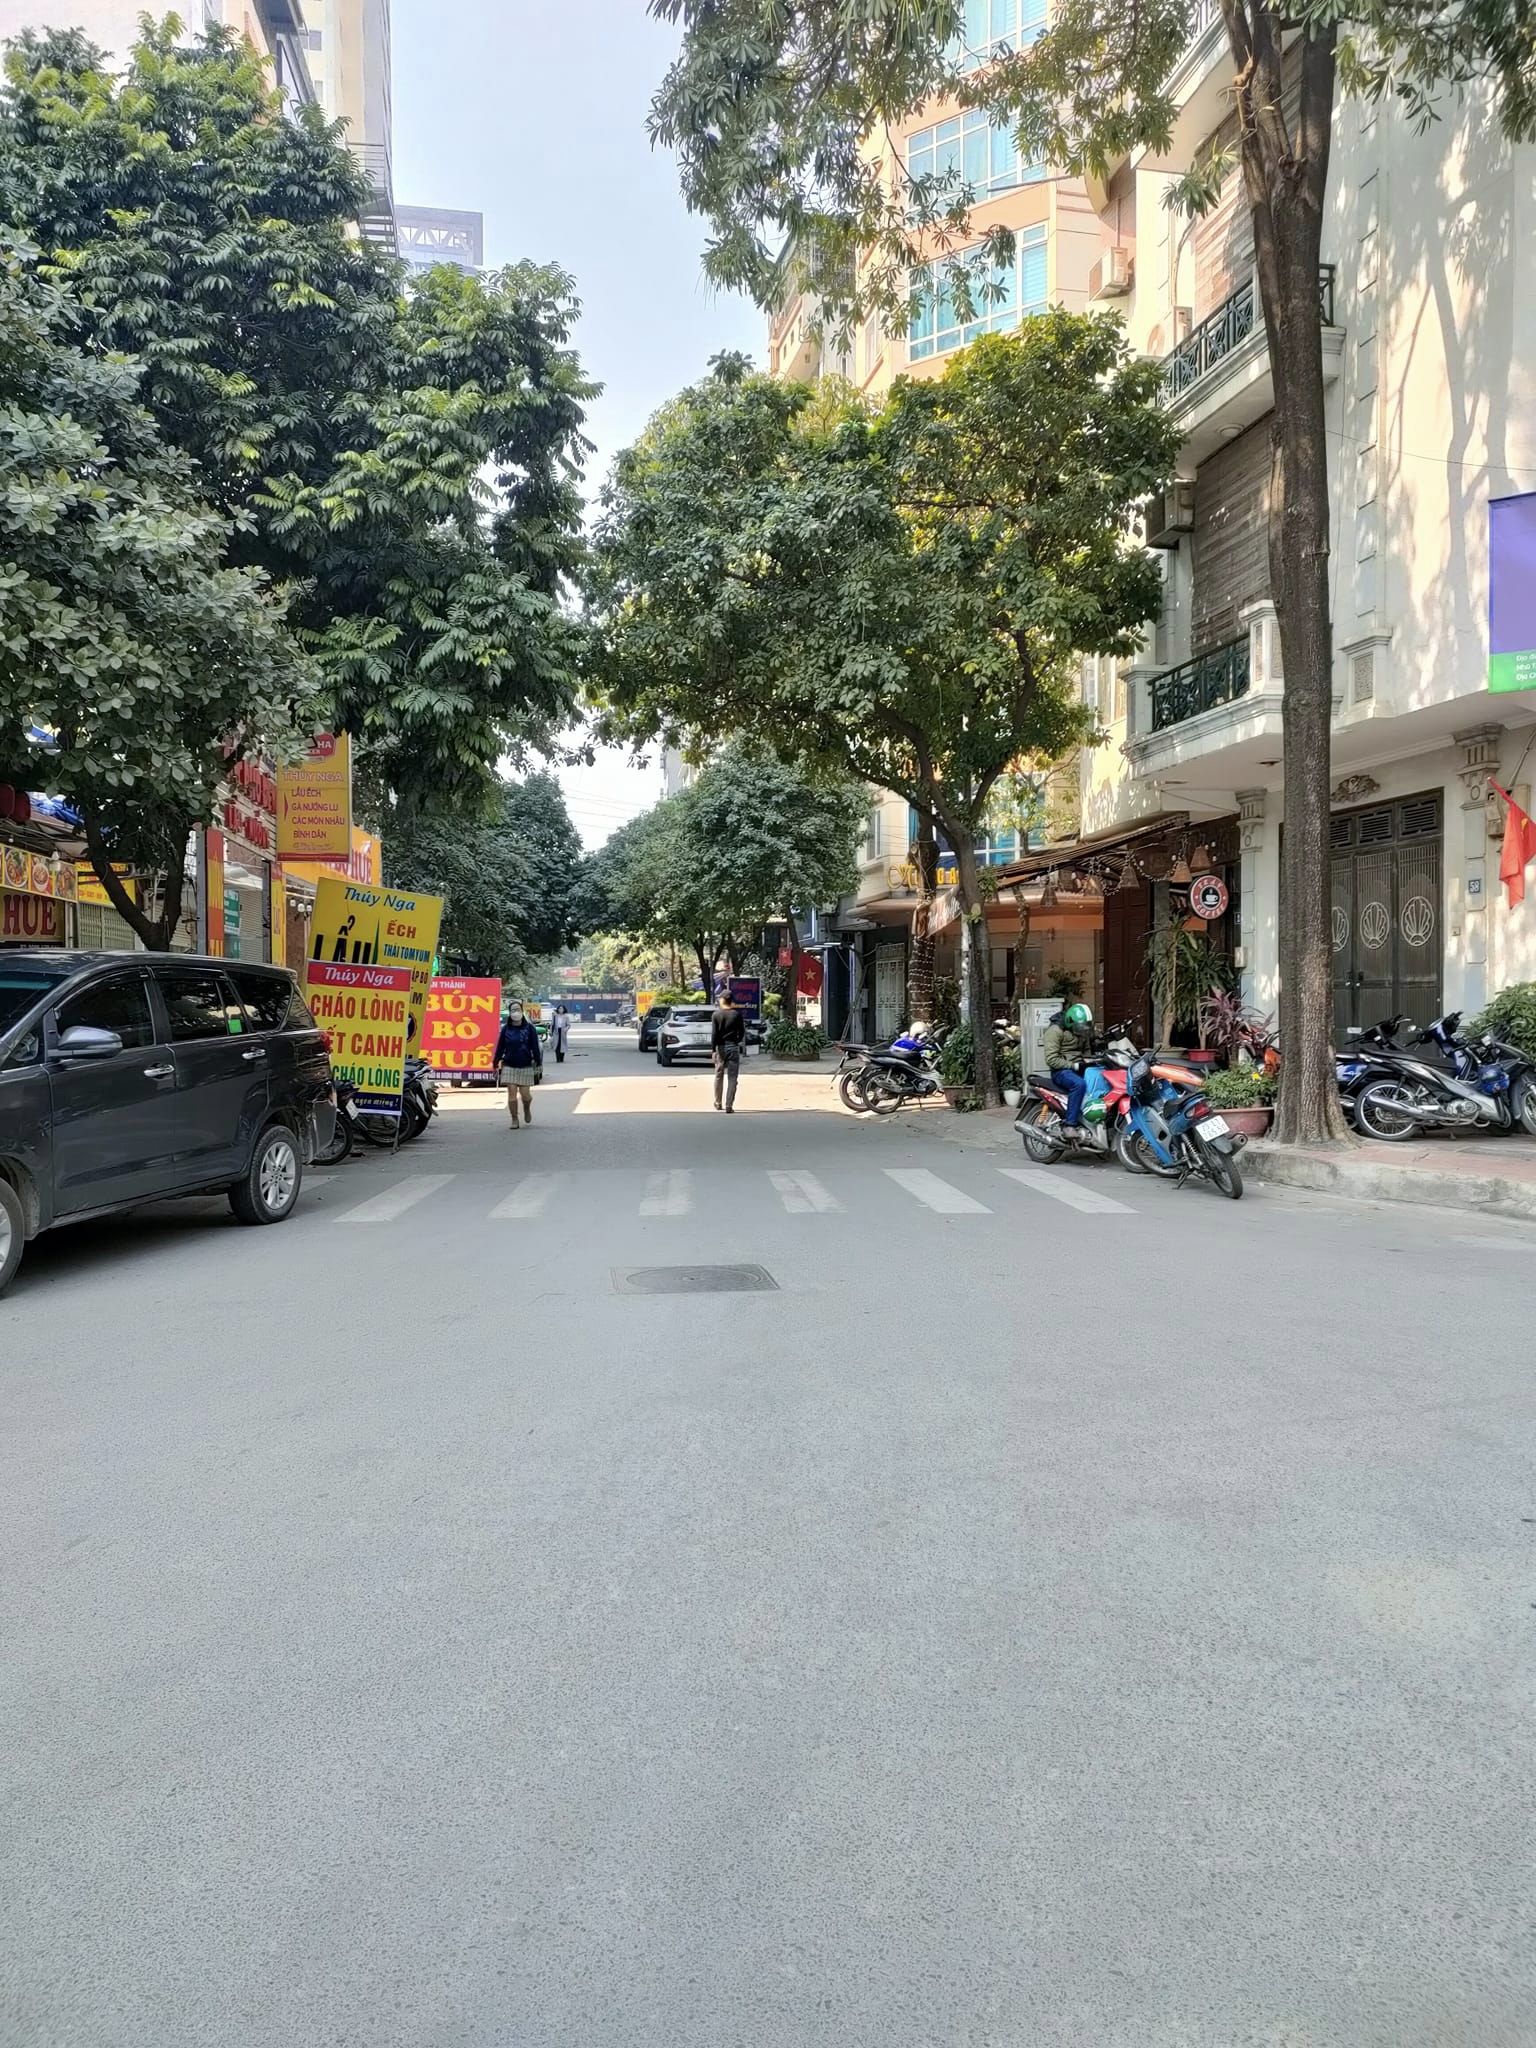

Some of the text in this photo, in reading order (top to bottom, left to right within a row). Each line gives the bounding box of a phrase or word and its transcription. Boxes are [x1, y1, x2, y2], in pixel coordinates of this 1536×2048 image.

[317, 772, 344, 782] NGA
[344, 887, 416, 912] Thúy Nga
[387, 919, 417, 939] ẾCH
[325, 967, 394, 985] Thúy Nga
[440, 980, 466, 989] THÀNH
[310, 992, 406, 1023] CHÁO LÒNG
[426, 989, 497, 1013] BÚN
[430, 1016, 481, 1040] BÒ
[328, 1024, 403, 1059] ẾT CANH
[419, 1043, 495, 1069] HUẾ
[332, 1062, 400, 1088] CHÁO LÒNG
